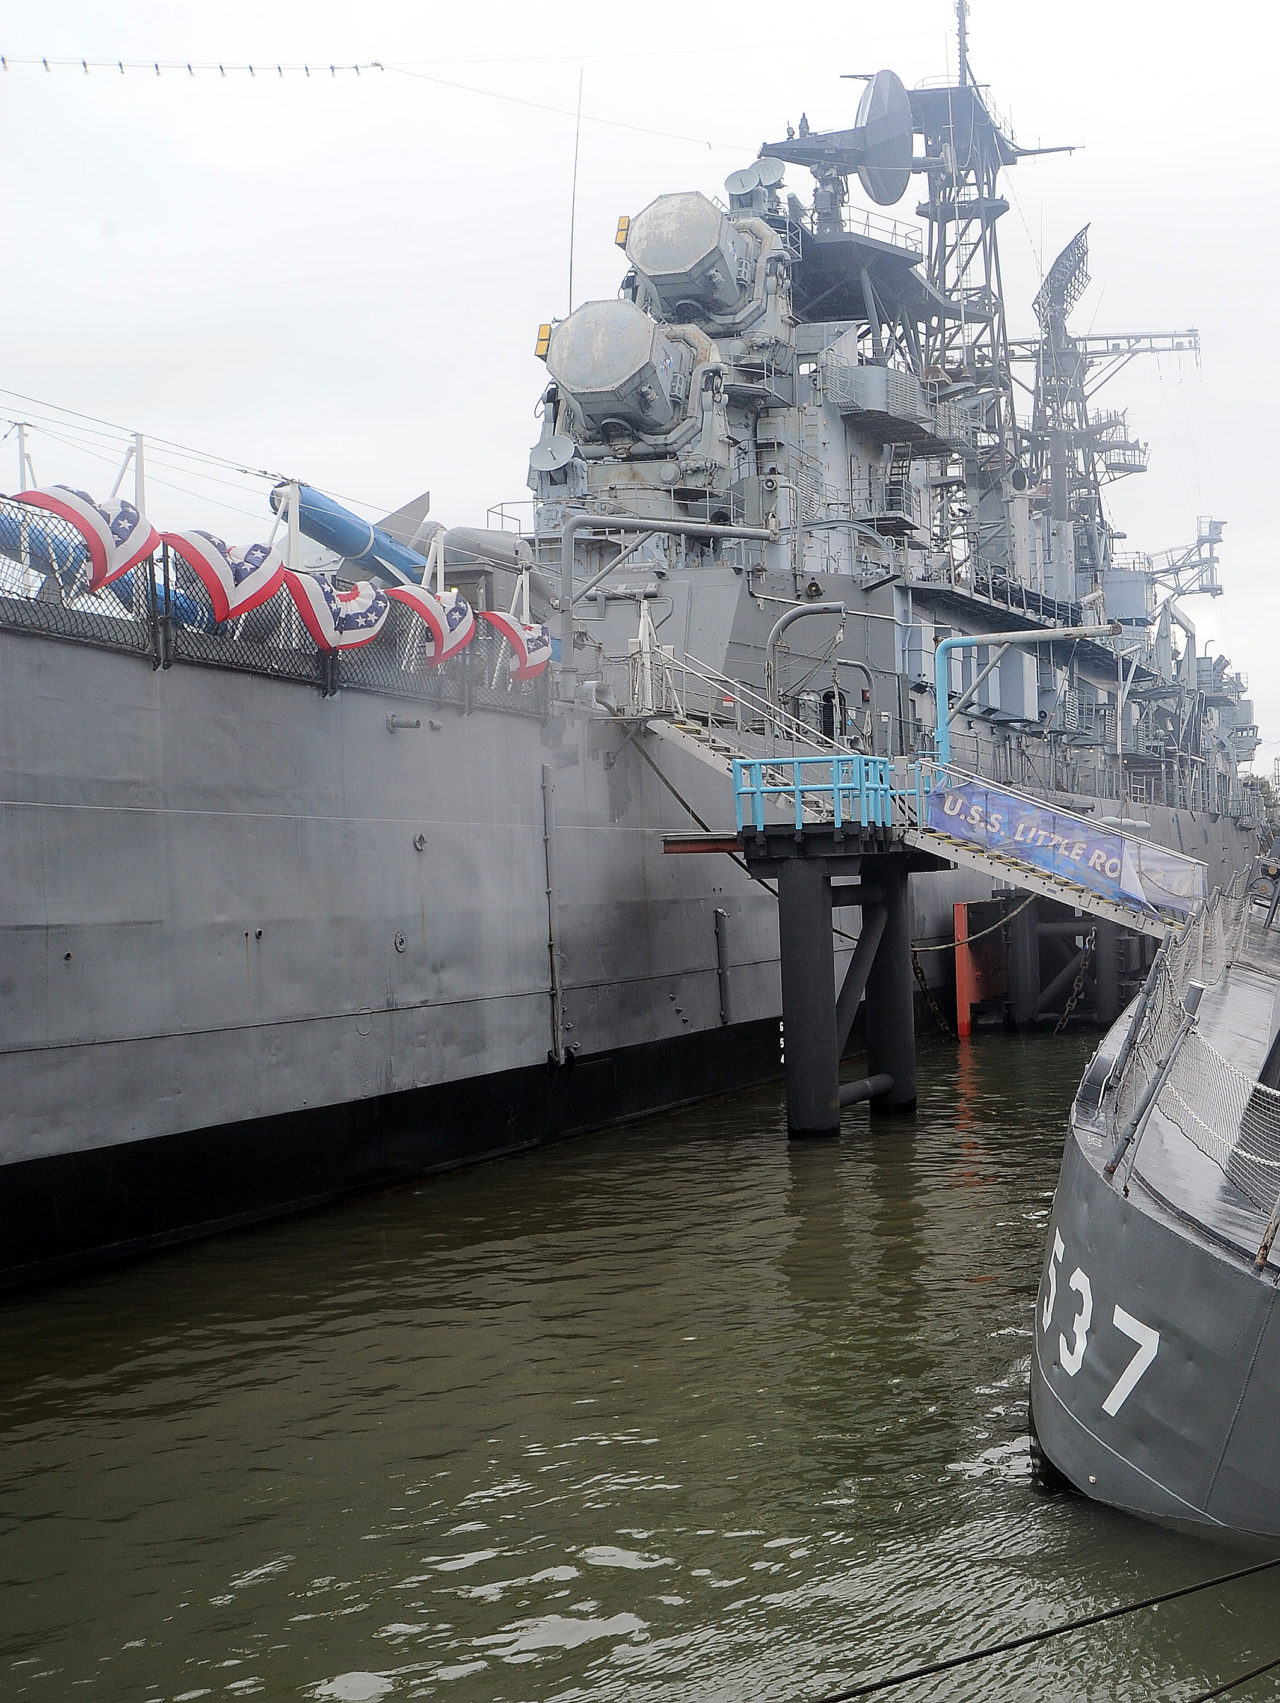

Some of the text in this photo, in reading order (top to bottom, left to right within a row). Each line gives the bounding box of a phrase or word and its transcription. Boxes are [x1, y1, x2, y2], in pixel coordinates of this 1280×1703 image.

[943, 794, 1006, 836] U.S.S.
[1013, 823, 1087, 861] LITTLE
[779, 1021, 784, 1031] 6
[780, 1037, 784, 1048] 5
[1042, 1226, 1160, 1418] 537
